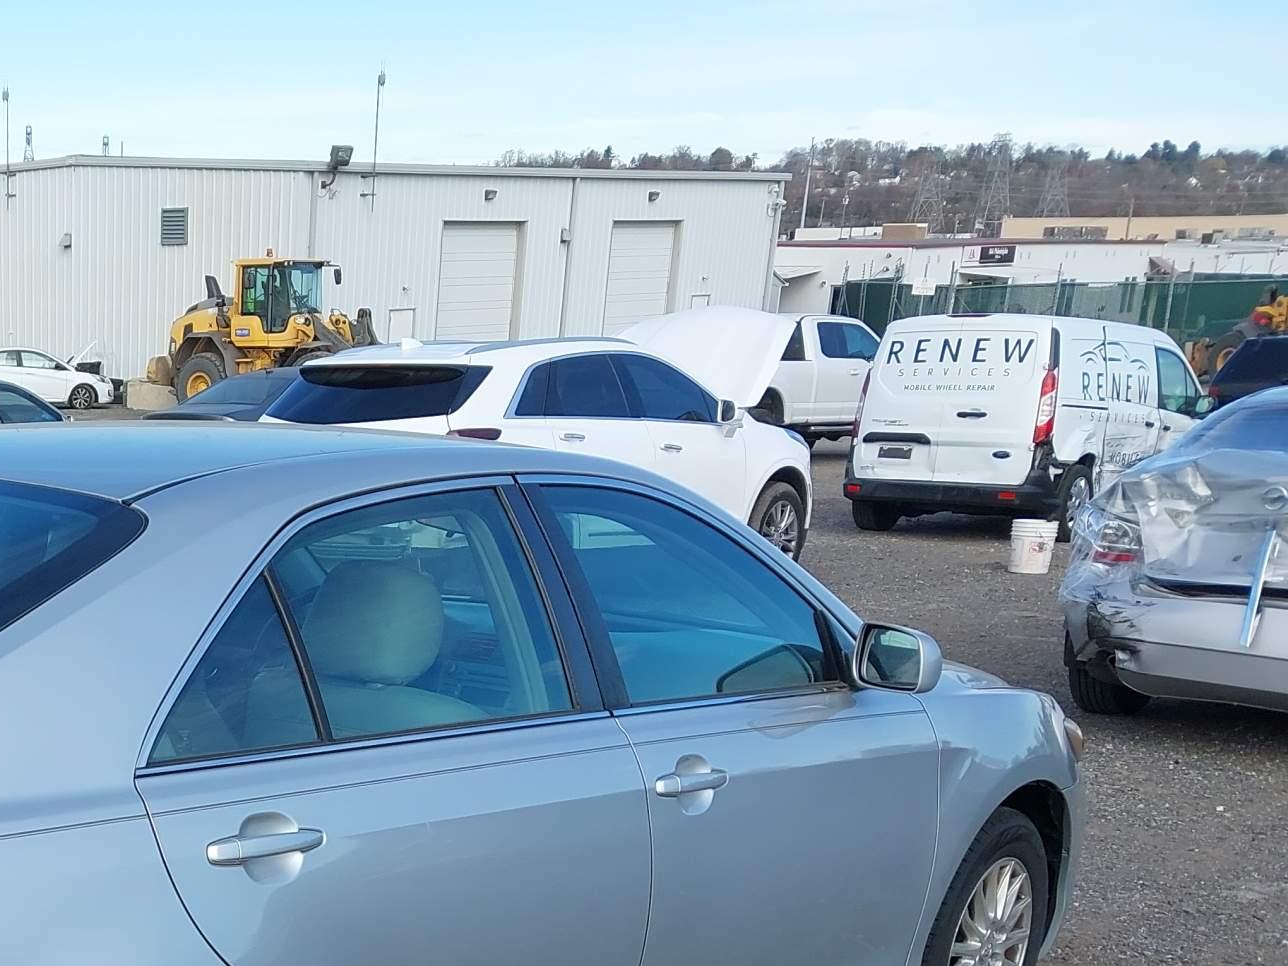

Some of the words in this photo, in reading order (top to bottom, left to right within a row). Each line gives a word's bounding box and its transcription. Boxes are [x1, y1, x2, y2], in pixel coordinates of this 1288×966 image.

[886, 338, 1035, 364] RENEW
[898, 367, 1012, 377] SERVICES
[1082, 372, 1150, 404] RENEW
